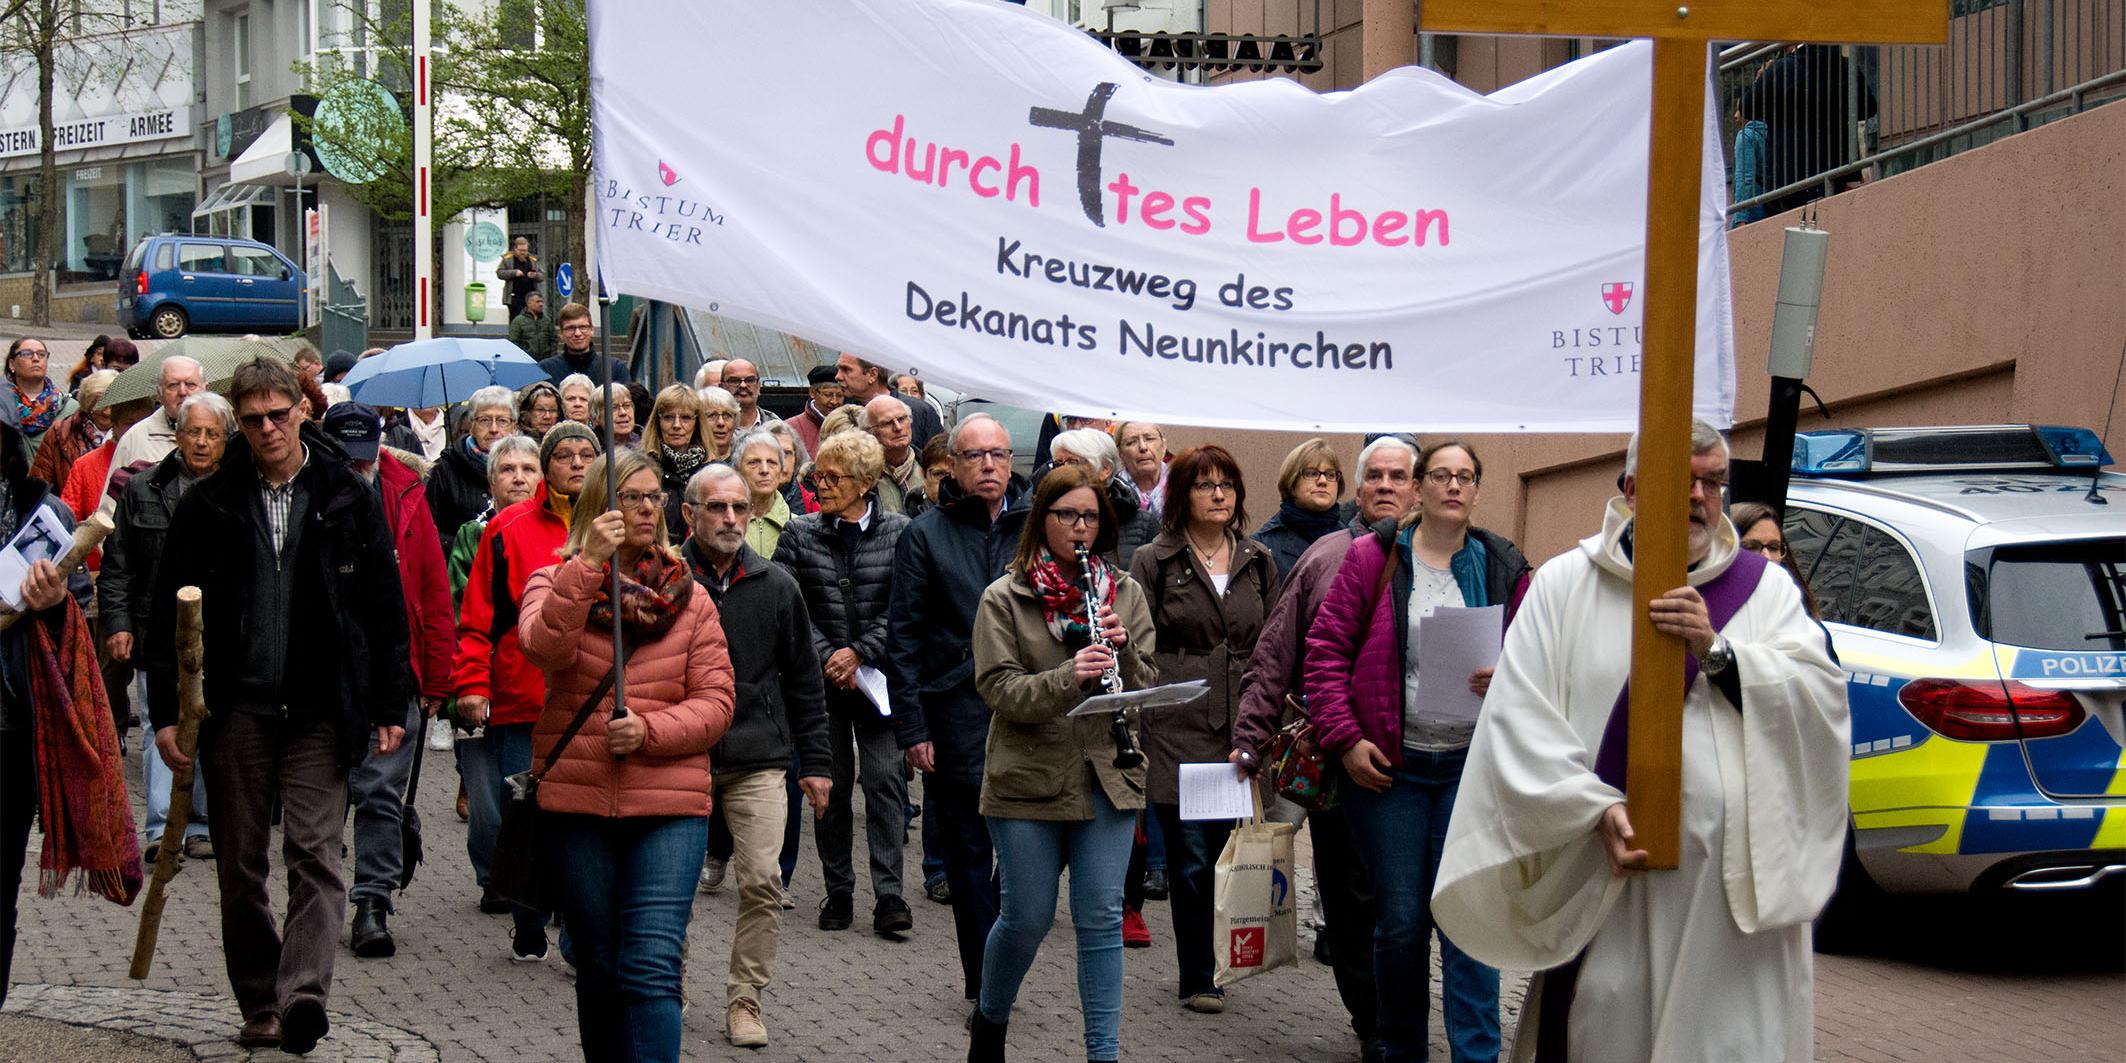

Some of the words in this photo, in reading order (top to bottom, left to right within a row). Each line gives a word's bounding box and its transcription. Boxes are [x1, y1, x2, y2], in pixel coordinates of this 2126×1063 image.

[52, 121, 105, 146] FREIZEIT
[130, 113, 173, 137] ARMEE
[866, 114, 1039, 207] durch
[607, 179, 724, 226] BISTUM
[611, 208, 702, 245] TRIER
[1247, 187, 1449, 247] Leben
[997, 236, 1197, 311] Kreuzweg
[1218, 273, 1294, 311] des
[906, 281, 1097, 350] Dekanats
[1120, 319, 1393, 370] Neunkirchen
[1564, 354, 1641, 377] TRIE
